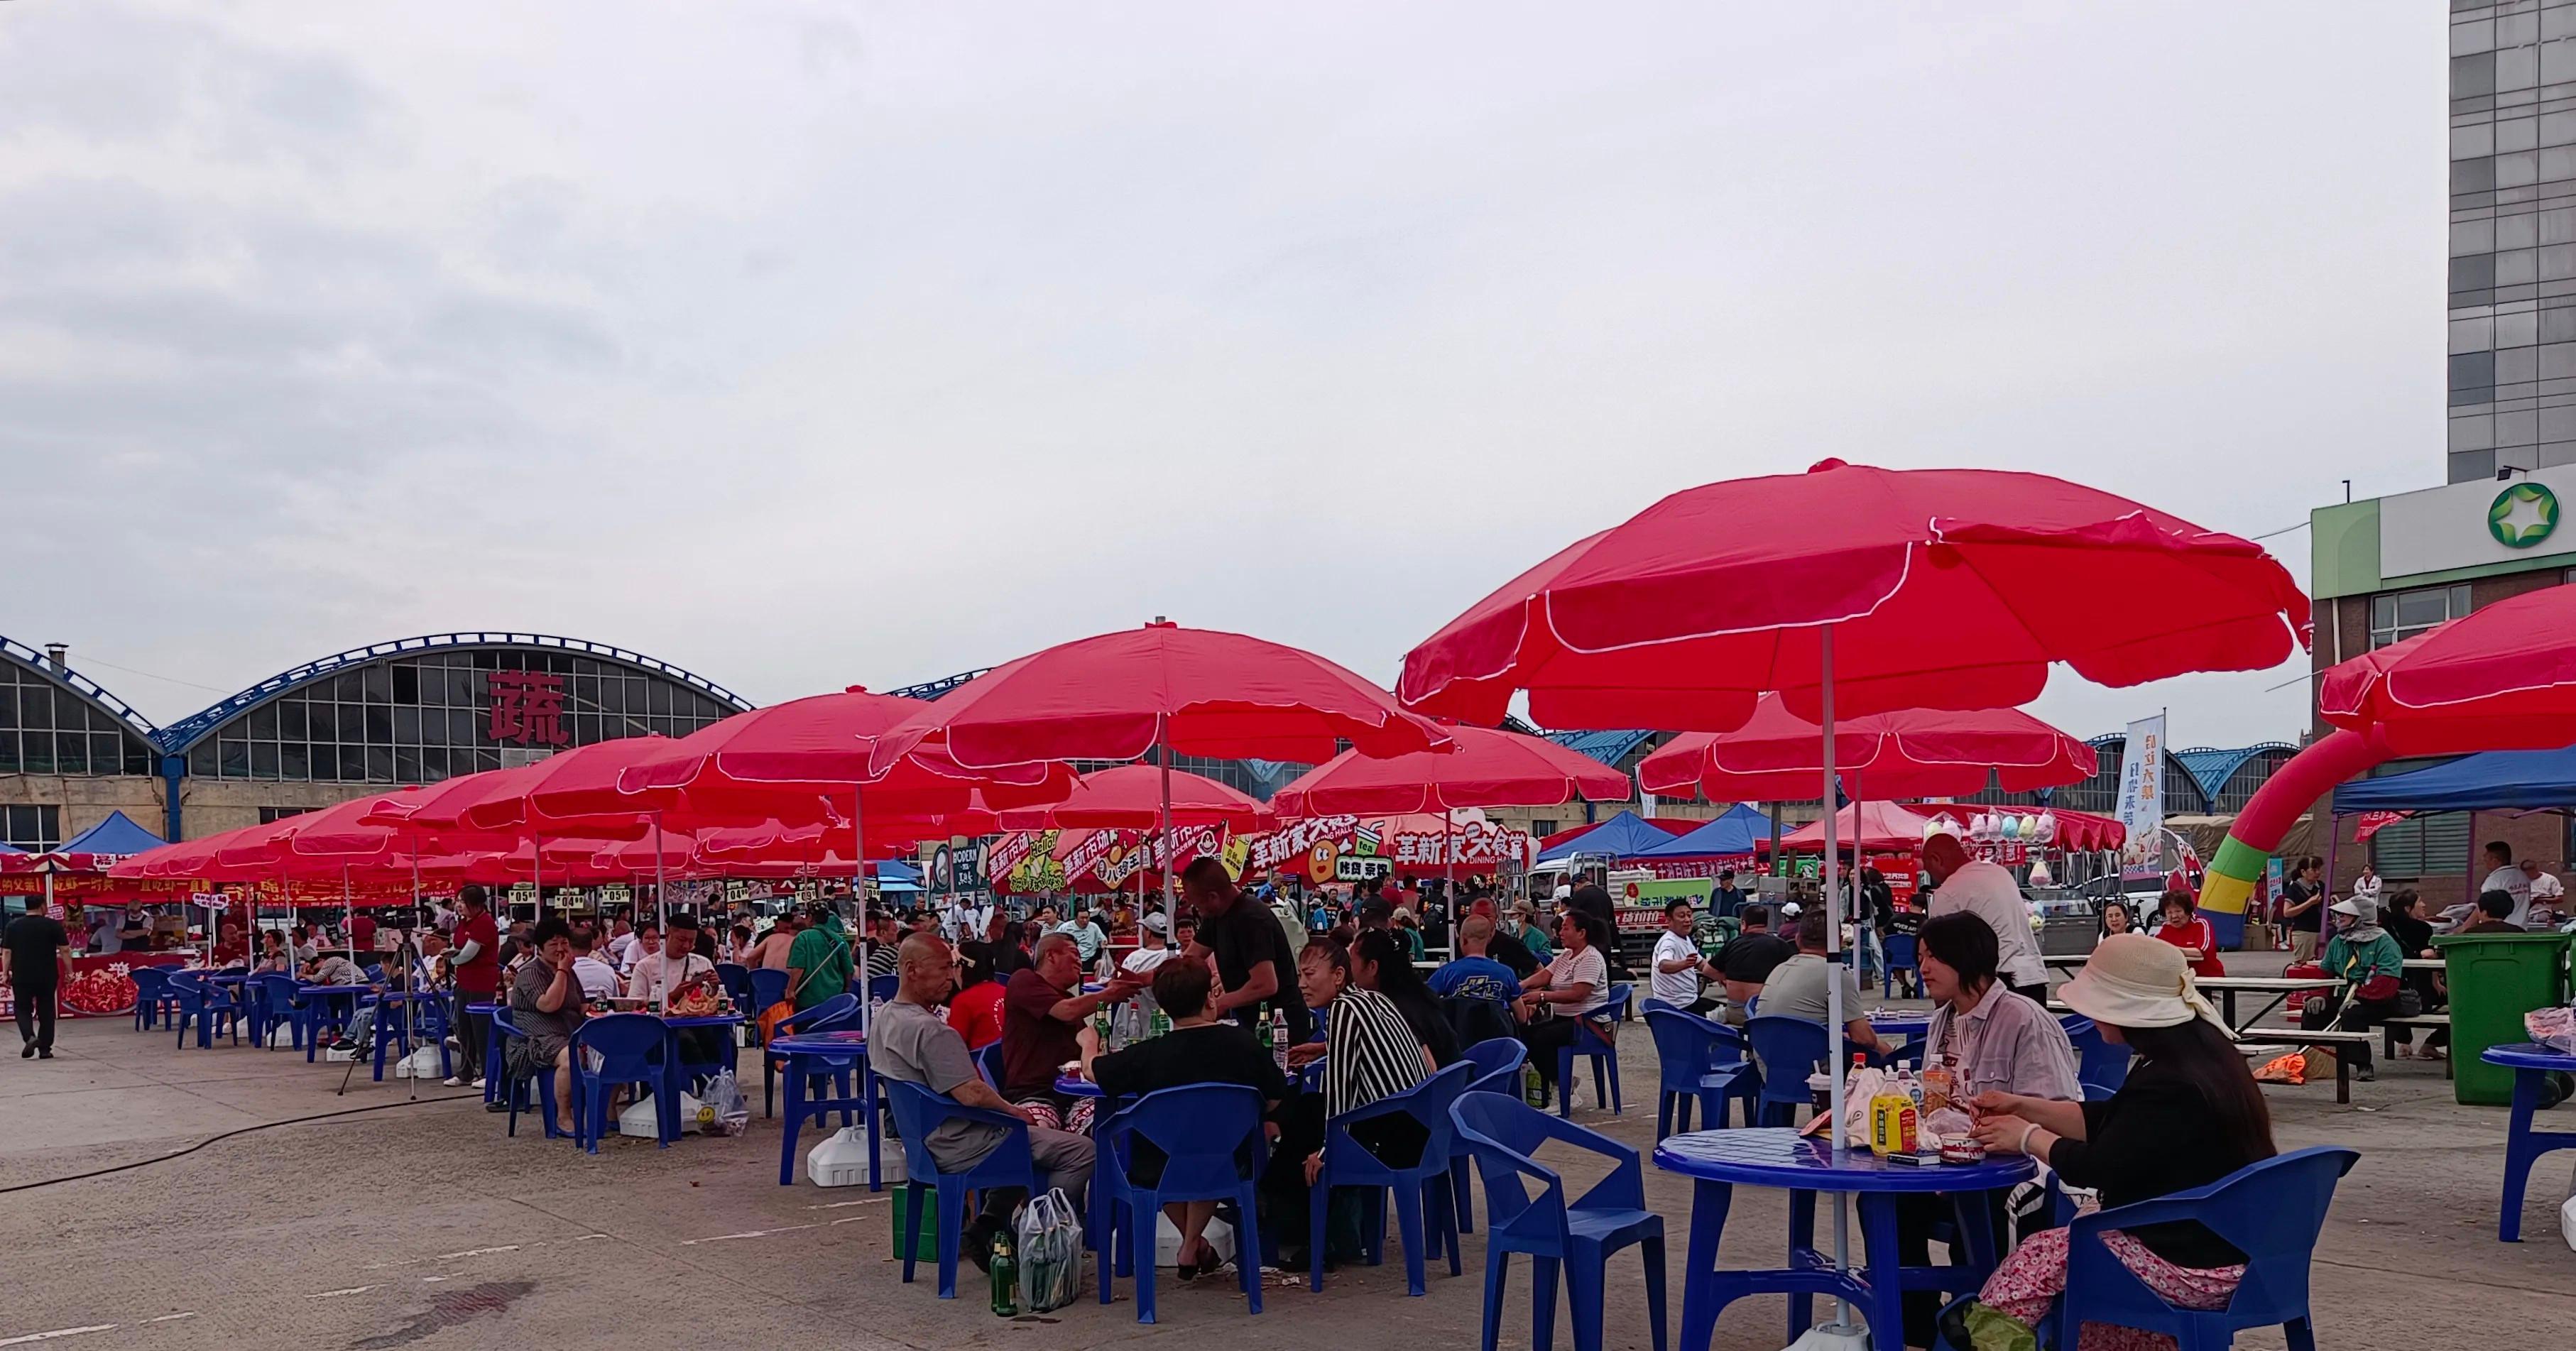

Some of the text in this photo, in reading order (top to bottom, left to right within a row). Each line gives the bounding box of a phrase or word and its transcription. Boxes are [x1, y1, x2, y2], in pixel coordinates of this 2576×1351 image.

[488, 669, 569, 745] 蔬
[1030, 833, 1057, 856] Hello!
[1062, 829, 1110, 877] 革新市场
[1359, 841, 1372, 853] tea
